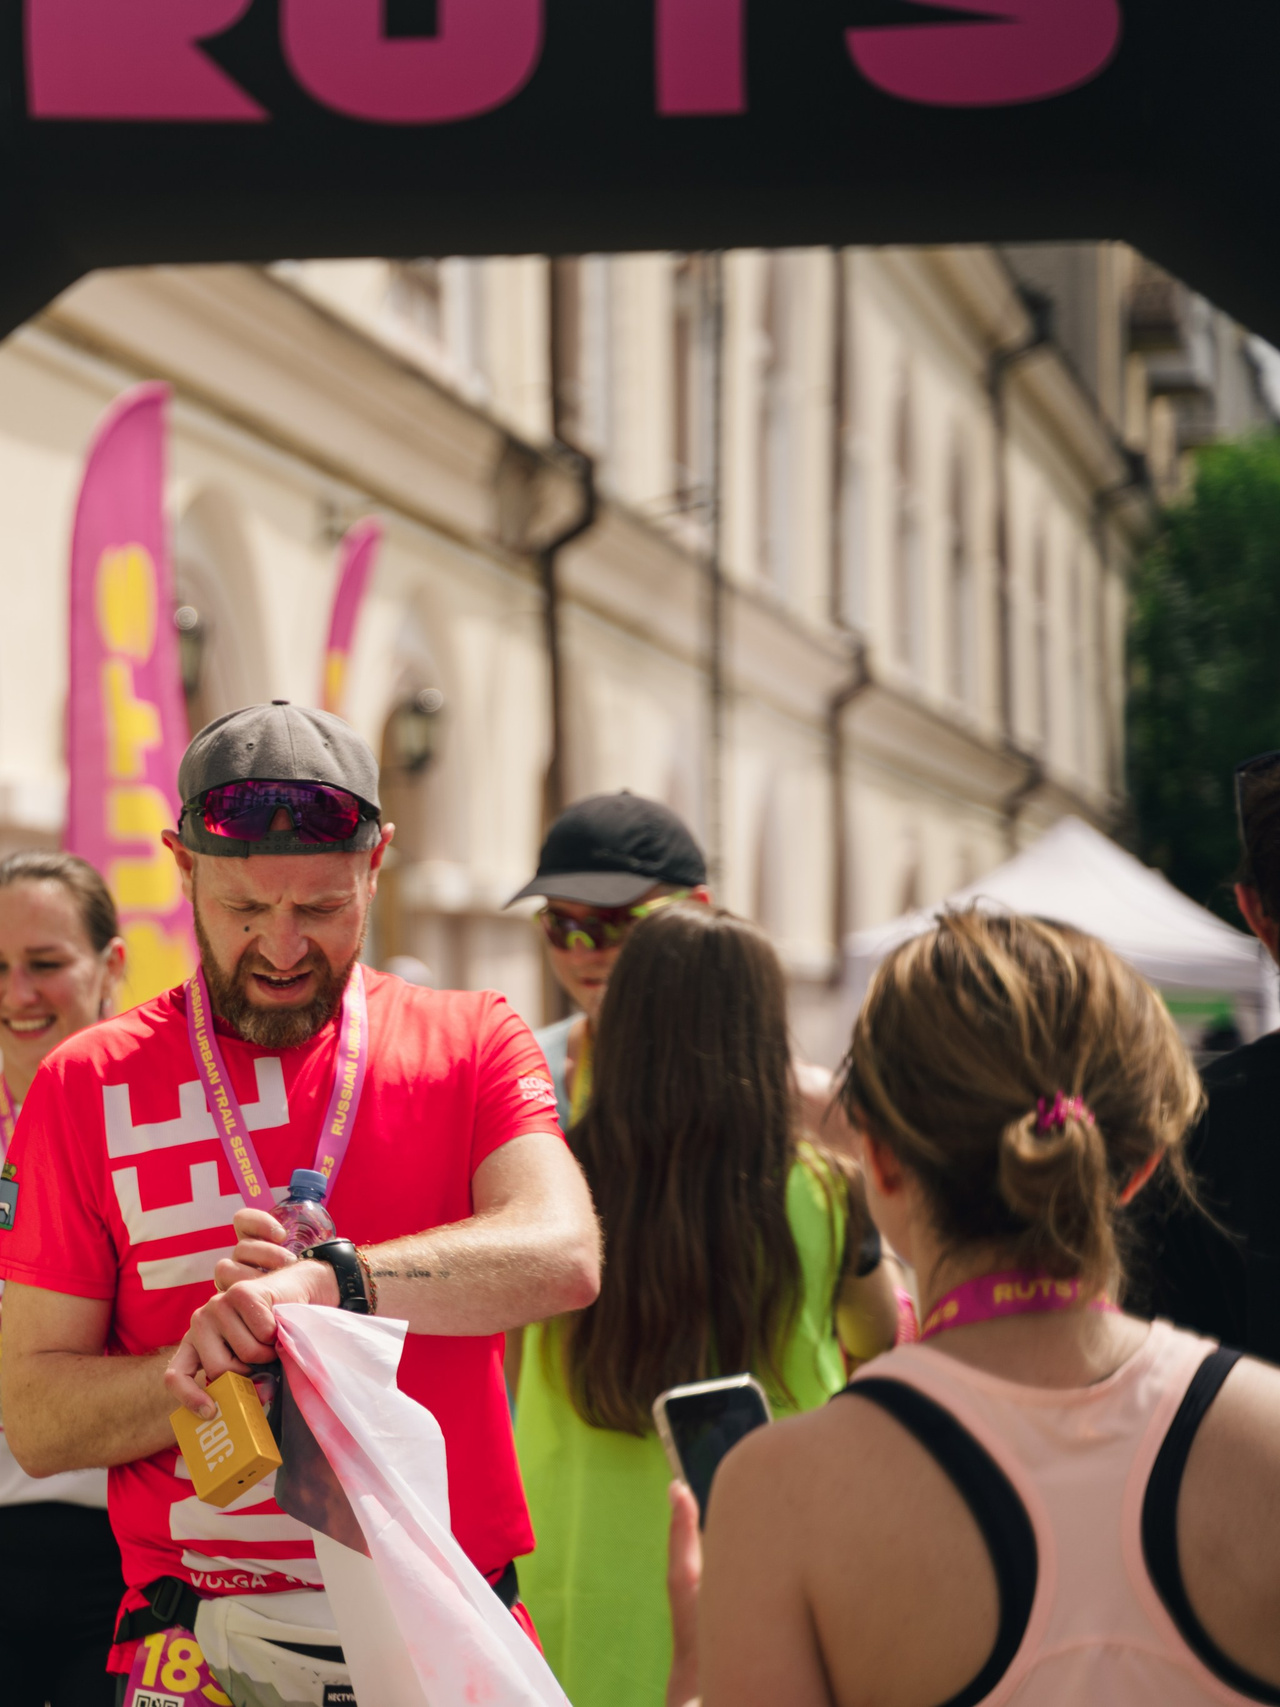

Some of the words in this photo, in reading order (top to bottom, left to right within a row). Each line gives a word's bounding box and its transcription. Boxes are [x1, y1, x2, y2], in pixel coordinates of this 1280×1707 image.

[196, 1028, 221, 1085] URBAN
[213, 1084, 237, 1135] TRAIL
[230, 1134, 262, 1197] SERIES
[331, 1060, 358, 1137] RUSSIAN
